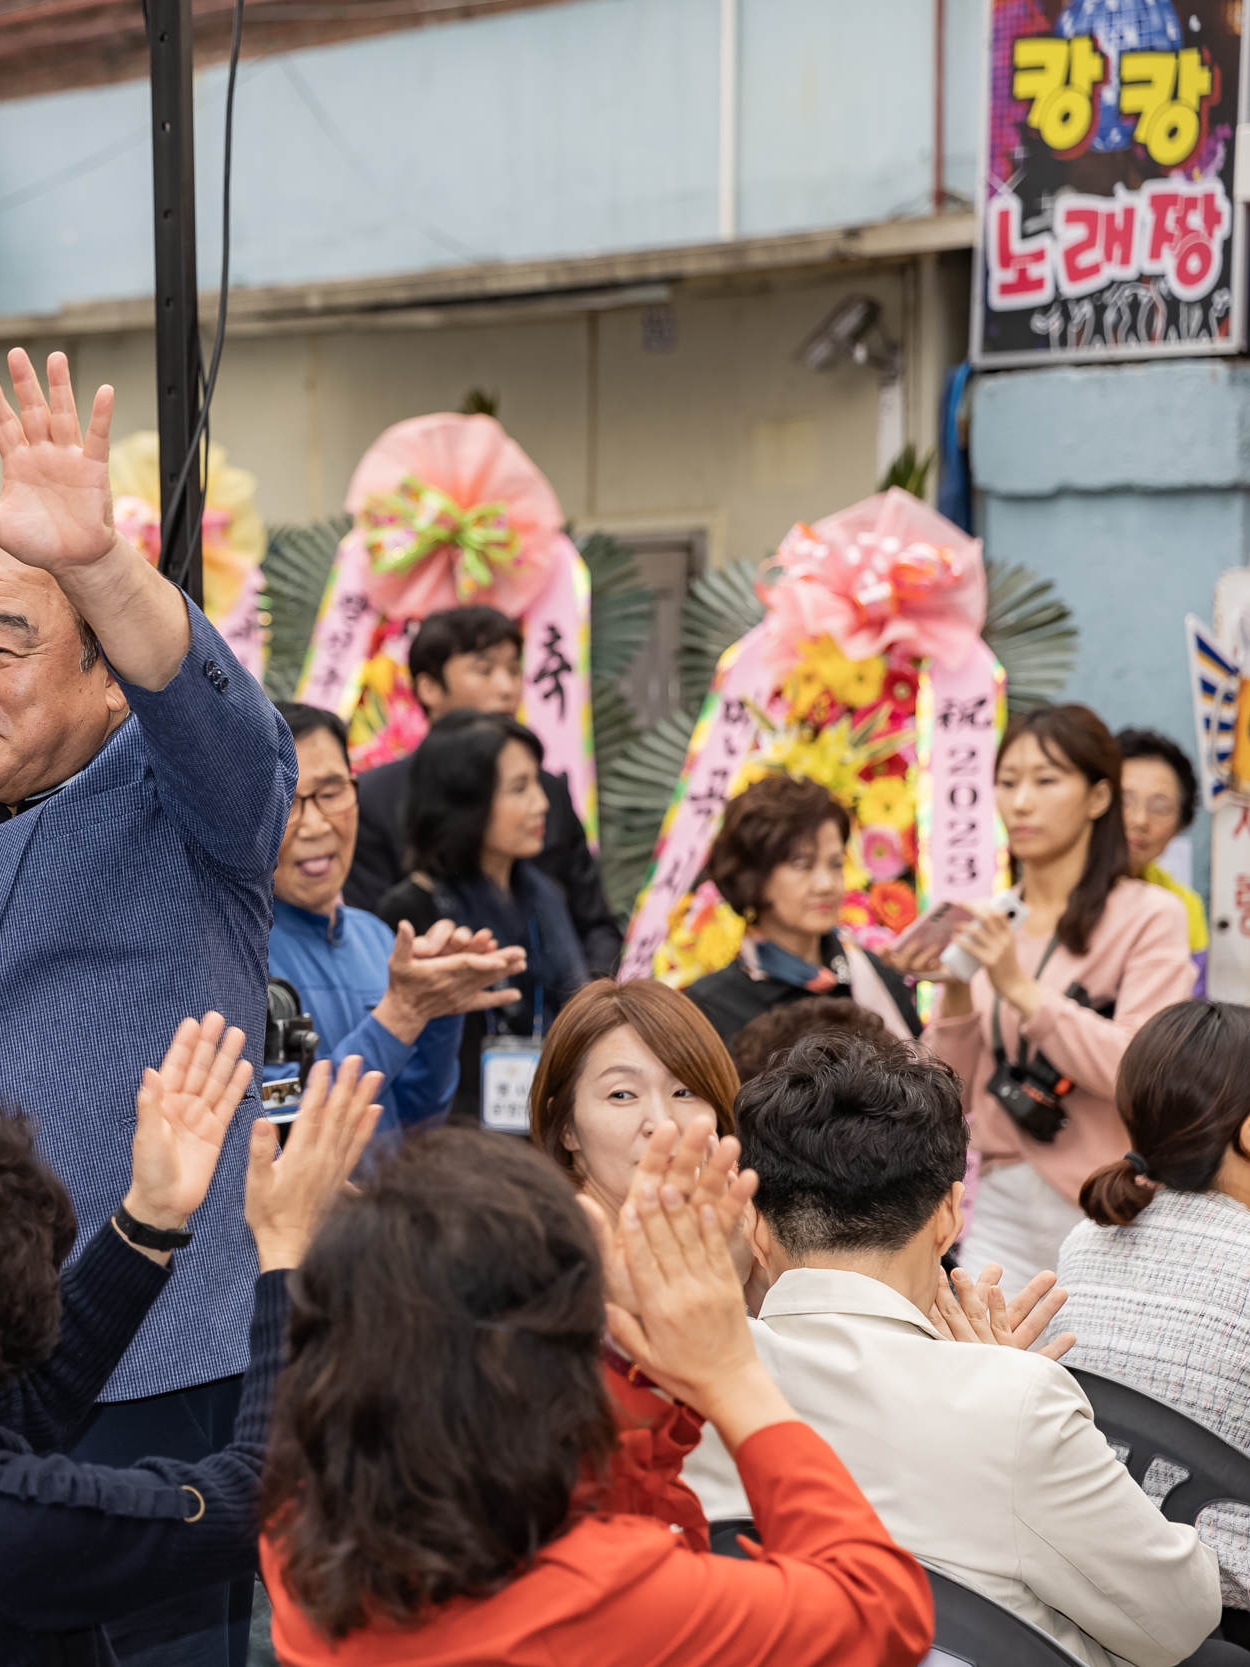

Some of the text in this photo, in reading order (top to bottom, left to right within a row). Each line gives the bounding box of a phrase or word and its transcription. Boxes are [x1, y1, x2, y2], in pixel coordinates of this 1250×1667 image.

[993, 187, 1226, 302] 노래짱
[937, 697, 993, 887] 祝 2023
